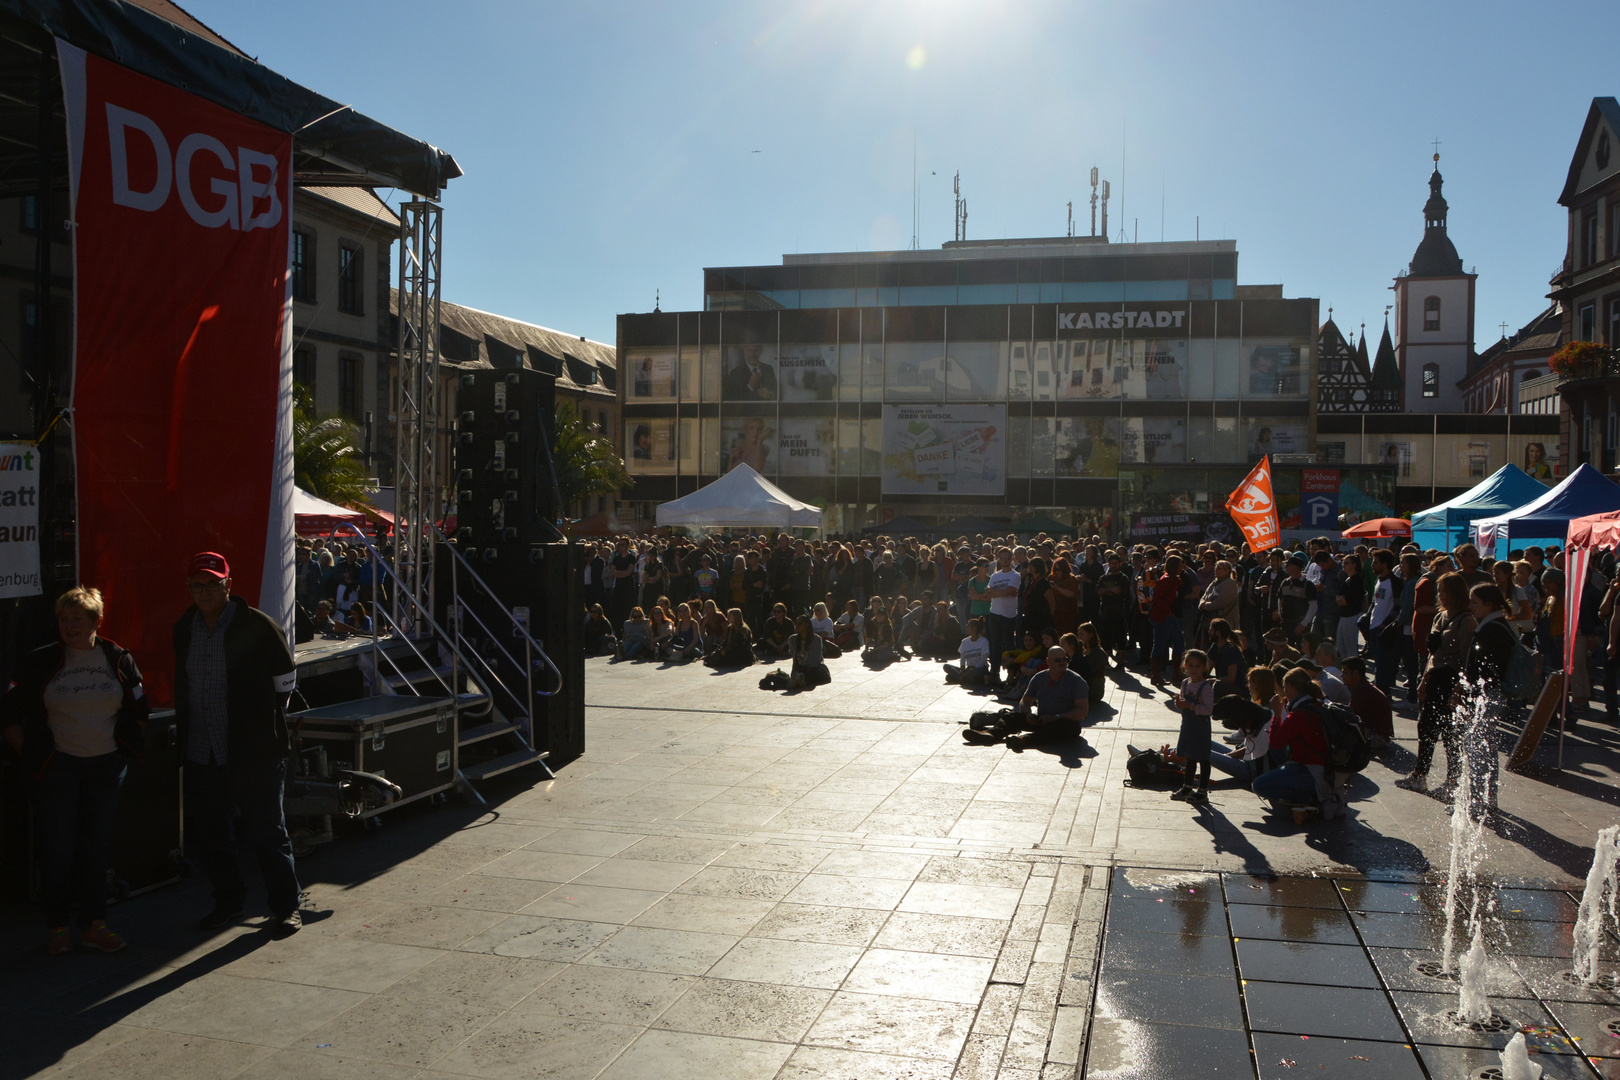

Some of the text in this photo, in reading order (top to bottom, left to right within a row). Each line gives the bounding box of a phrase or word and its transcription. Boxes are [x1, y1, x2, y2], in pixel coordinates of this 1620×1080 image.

[105, 101, 282, 233] DGB
[1059, 311, 1186, 329] KARSTADT
[780, 439, 807, 448] MEIN
[960, 433, 981, 448] LIEBE
[790, 448, 820, 457] DUFT!
[917, 450, 949, 463] DANKE
[0, 451, 34, 471] unt
[1304, 472, 1337, 481] Parkhaus
[1305, 481, 1335, 490] Zentrum
[0, 486, 36, 506] att
[1141, 515, 1190, 525] GEMEINSAM GEGEN
[1311, 503, 1330, 525] P
[1132, 525, 1201, 536] NEONAZIS UND RASSISMUS
